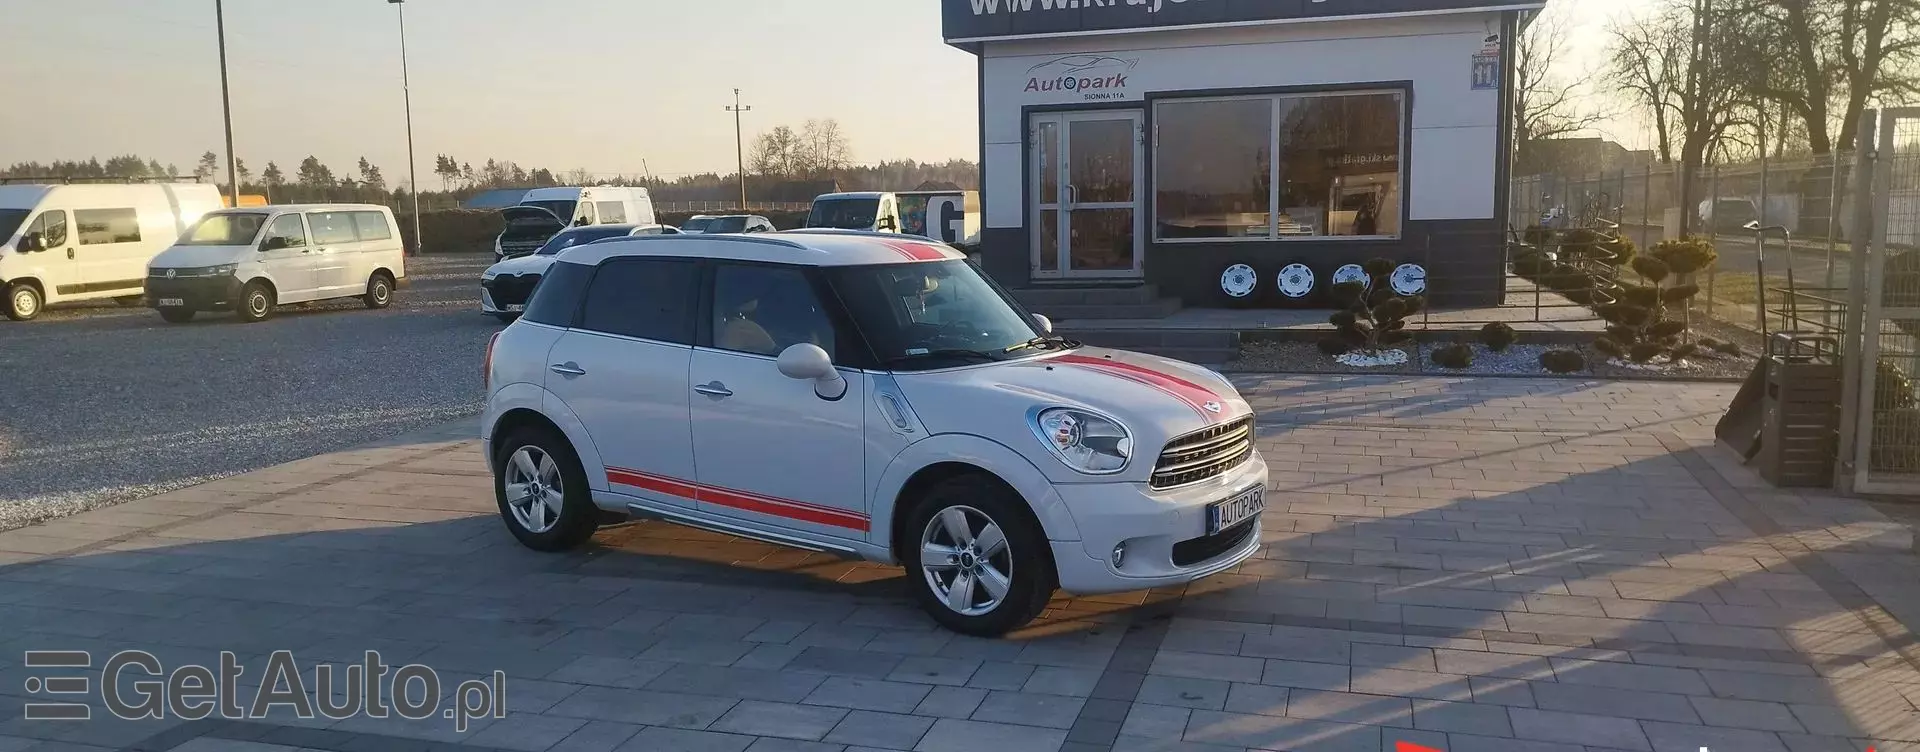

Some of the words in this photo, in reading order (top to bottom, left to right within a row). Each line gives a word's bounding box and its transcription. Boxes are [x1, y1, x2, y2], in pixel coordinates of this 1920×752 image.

[1024, 73, 1128, 92] Autopark
[1084, 92, 1111, 101] SIONNA
[1221, 487, 1264, 528] AUTOPARK
